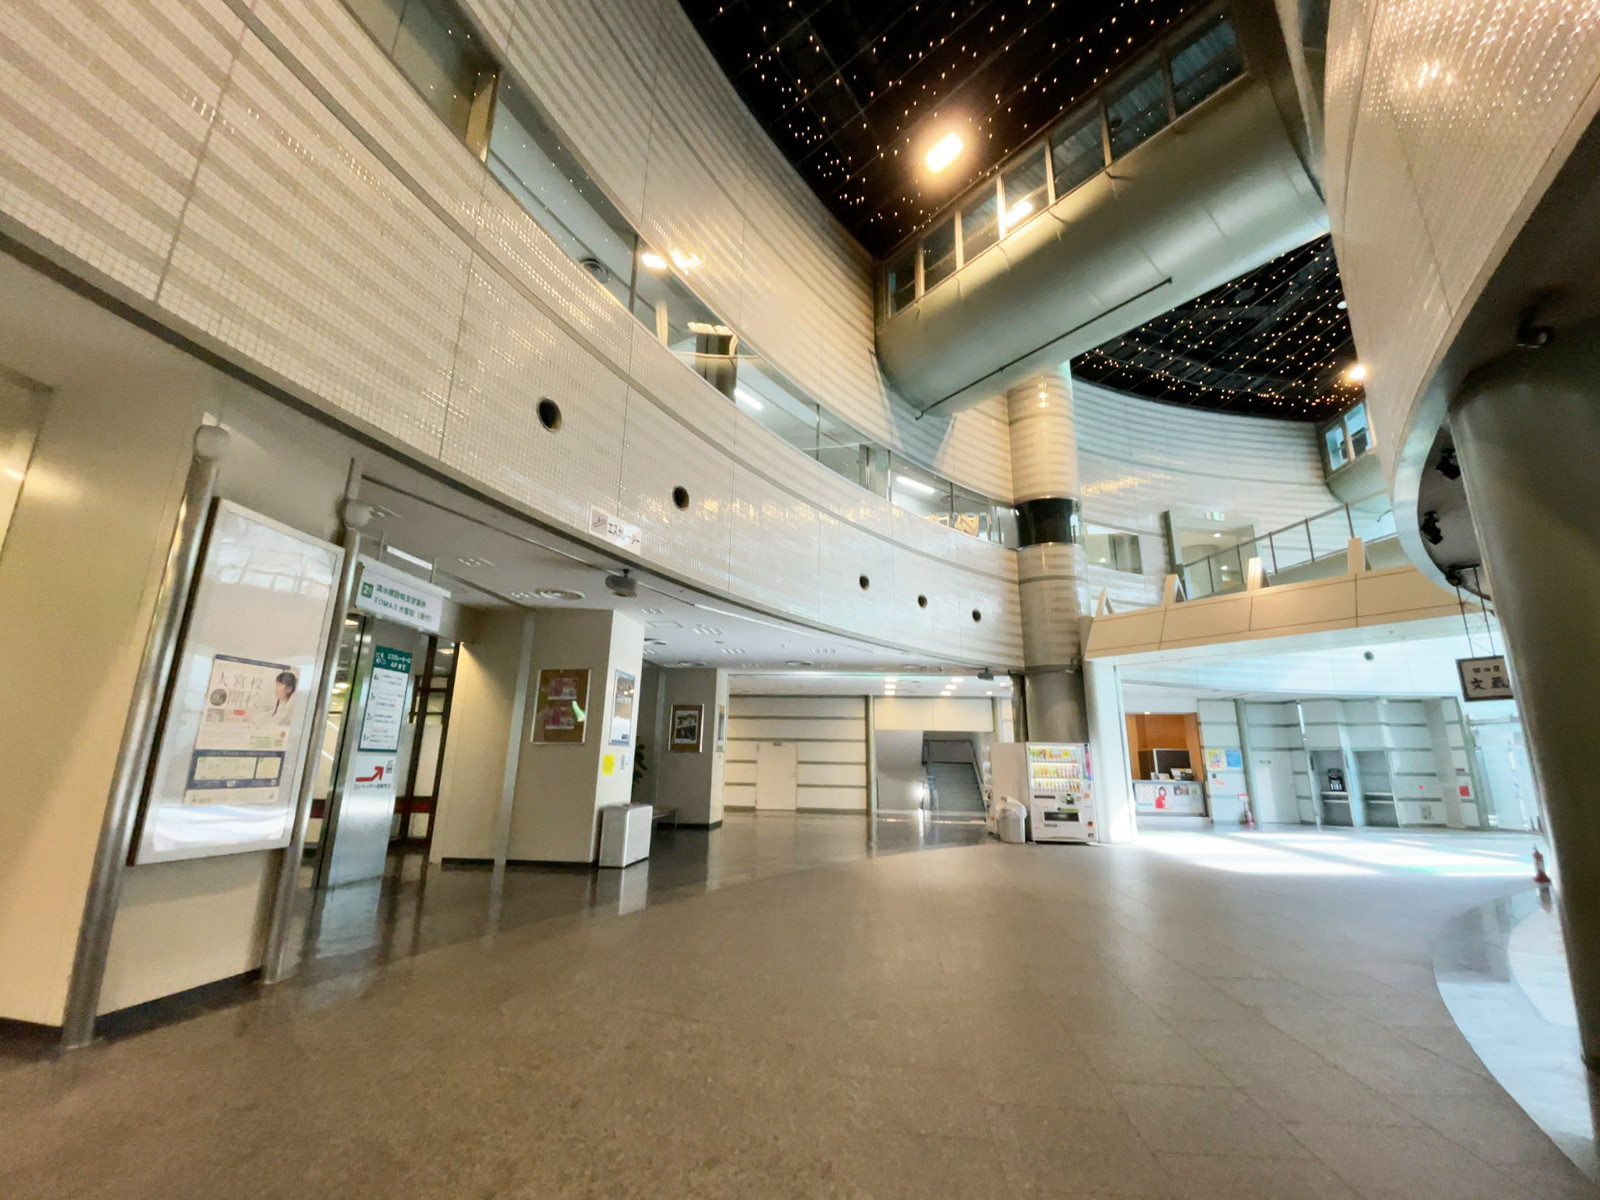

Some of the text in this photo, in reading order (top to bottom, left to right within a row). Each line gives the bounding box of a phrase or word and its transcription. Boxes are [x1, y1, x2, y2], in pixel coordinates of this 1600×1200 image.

[608, 522, 640, 545] エスカレーター
[374, 597, 398, 611] TOMAS
